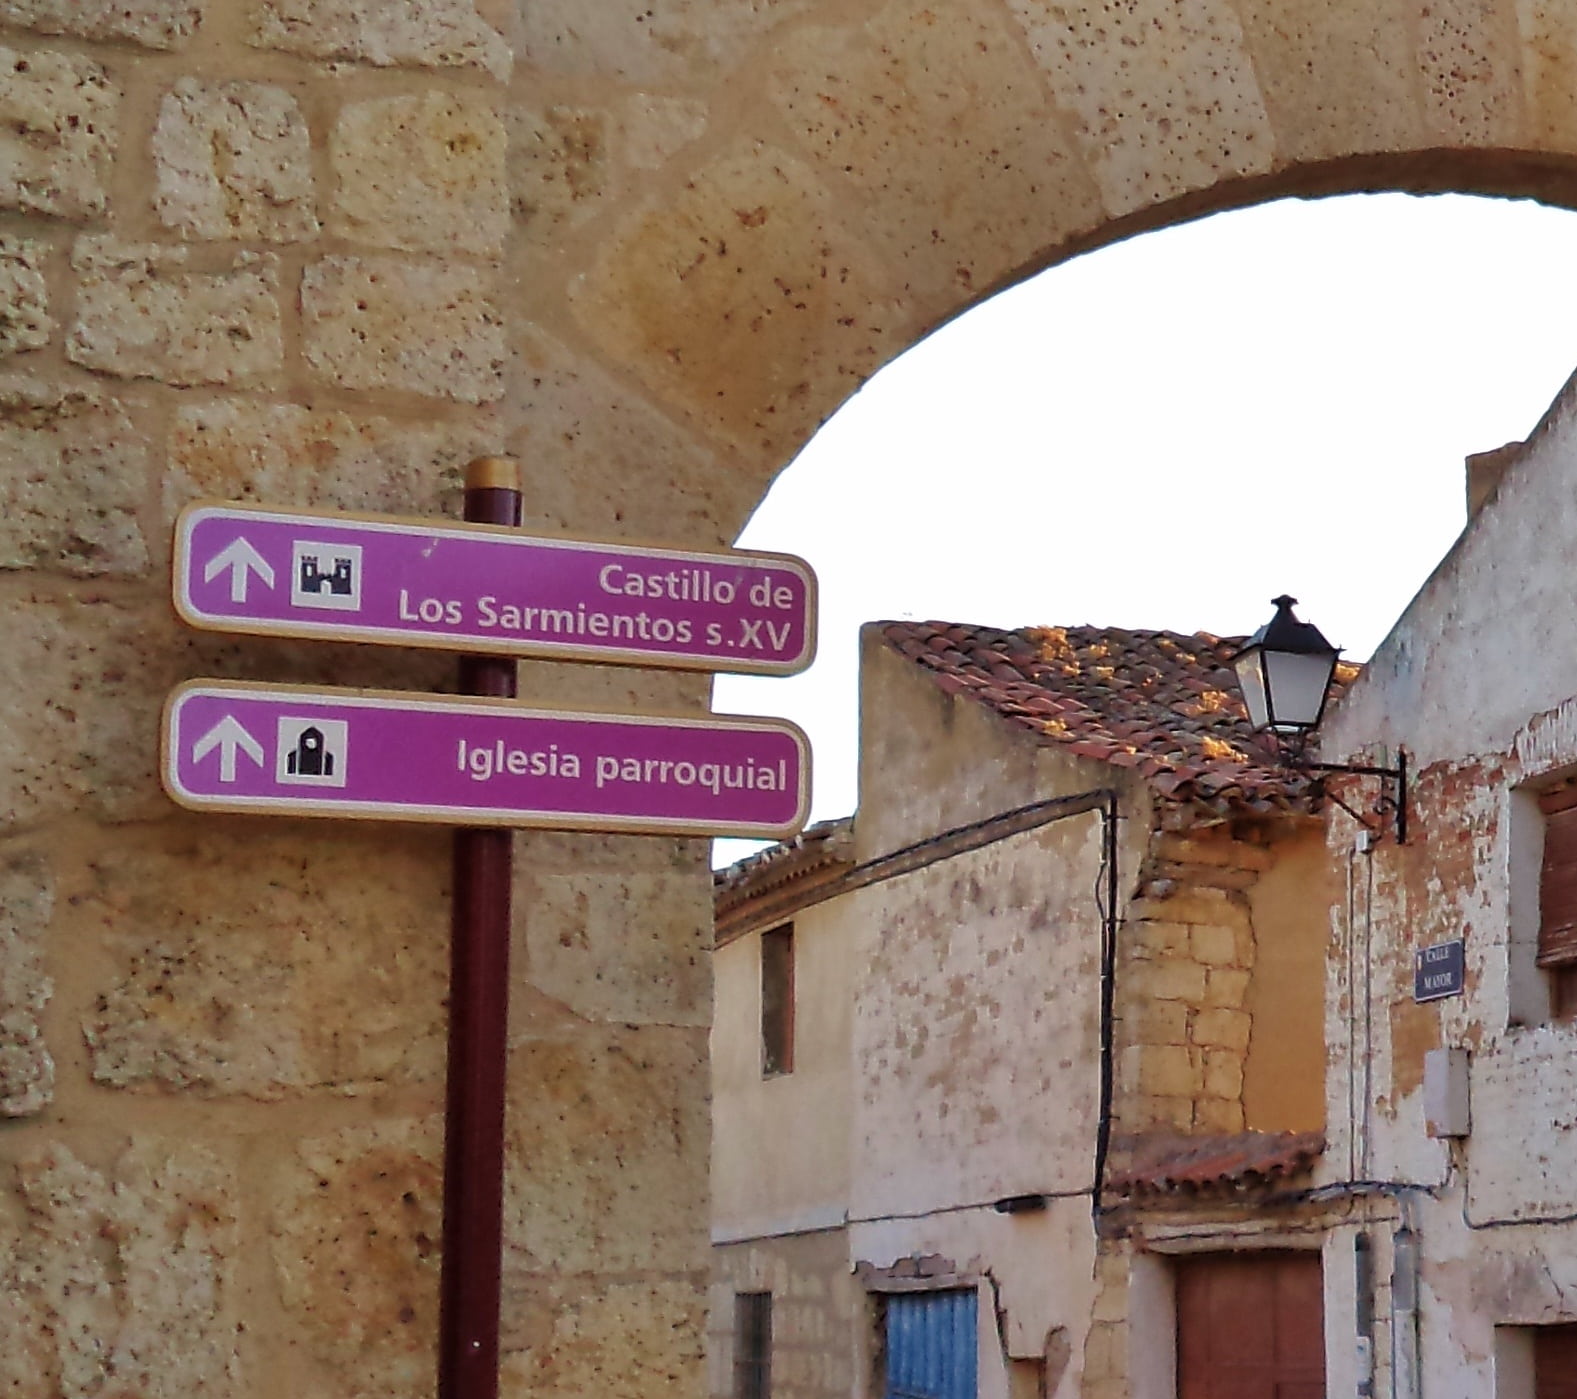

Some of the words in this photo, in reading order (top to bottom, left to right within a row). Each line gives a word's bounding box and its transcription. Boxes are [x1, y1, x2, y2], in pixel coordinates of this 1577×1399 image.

[599, 564, 736, 605] Castillo
[749, 576, 793, 610] de
[398, 589, 463, 625] Los
[477, 596, 692, 643] Sarmientos
[705, 618, 792, 651] s.XV
[457, 739, 580, 781] Iglesia
[596, 755, 786, 795] parroquial
[1426, 946, 1449, 962] CALLE
[1424, 972, 1452, 989] MAYOR
